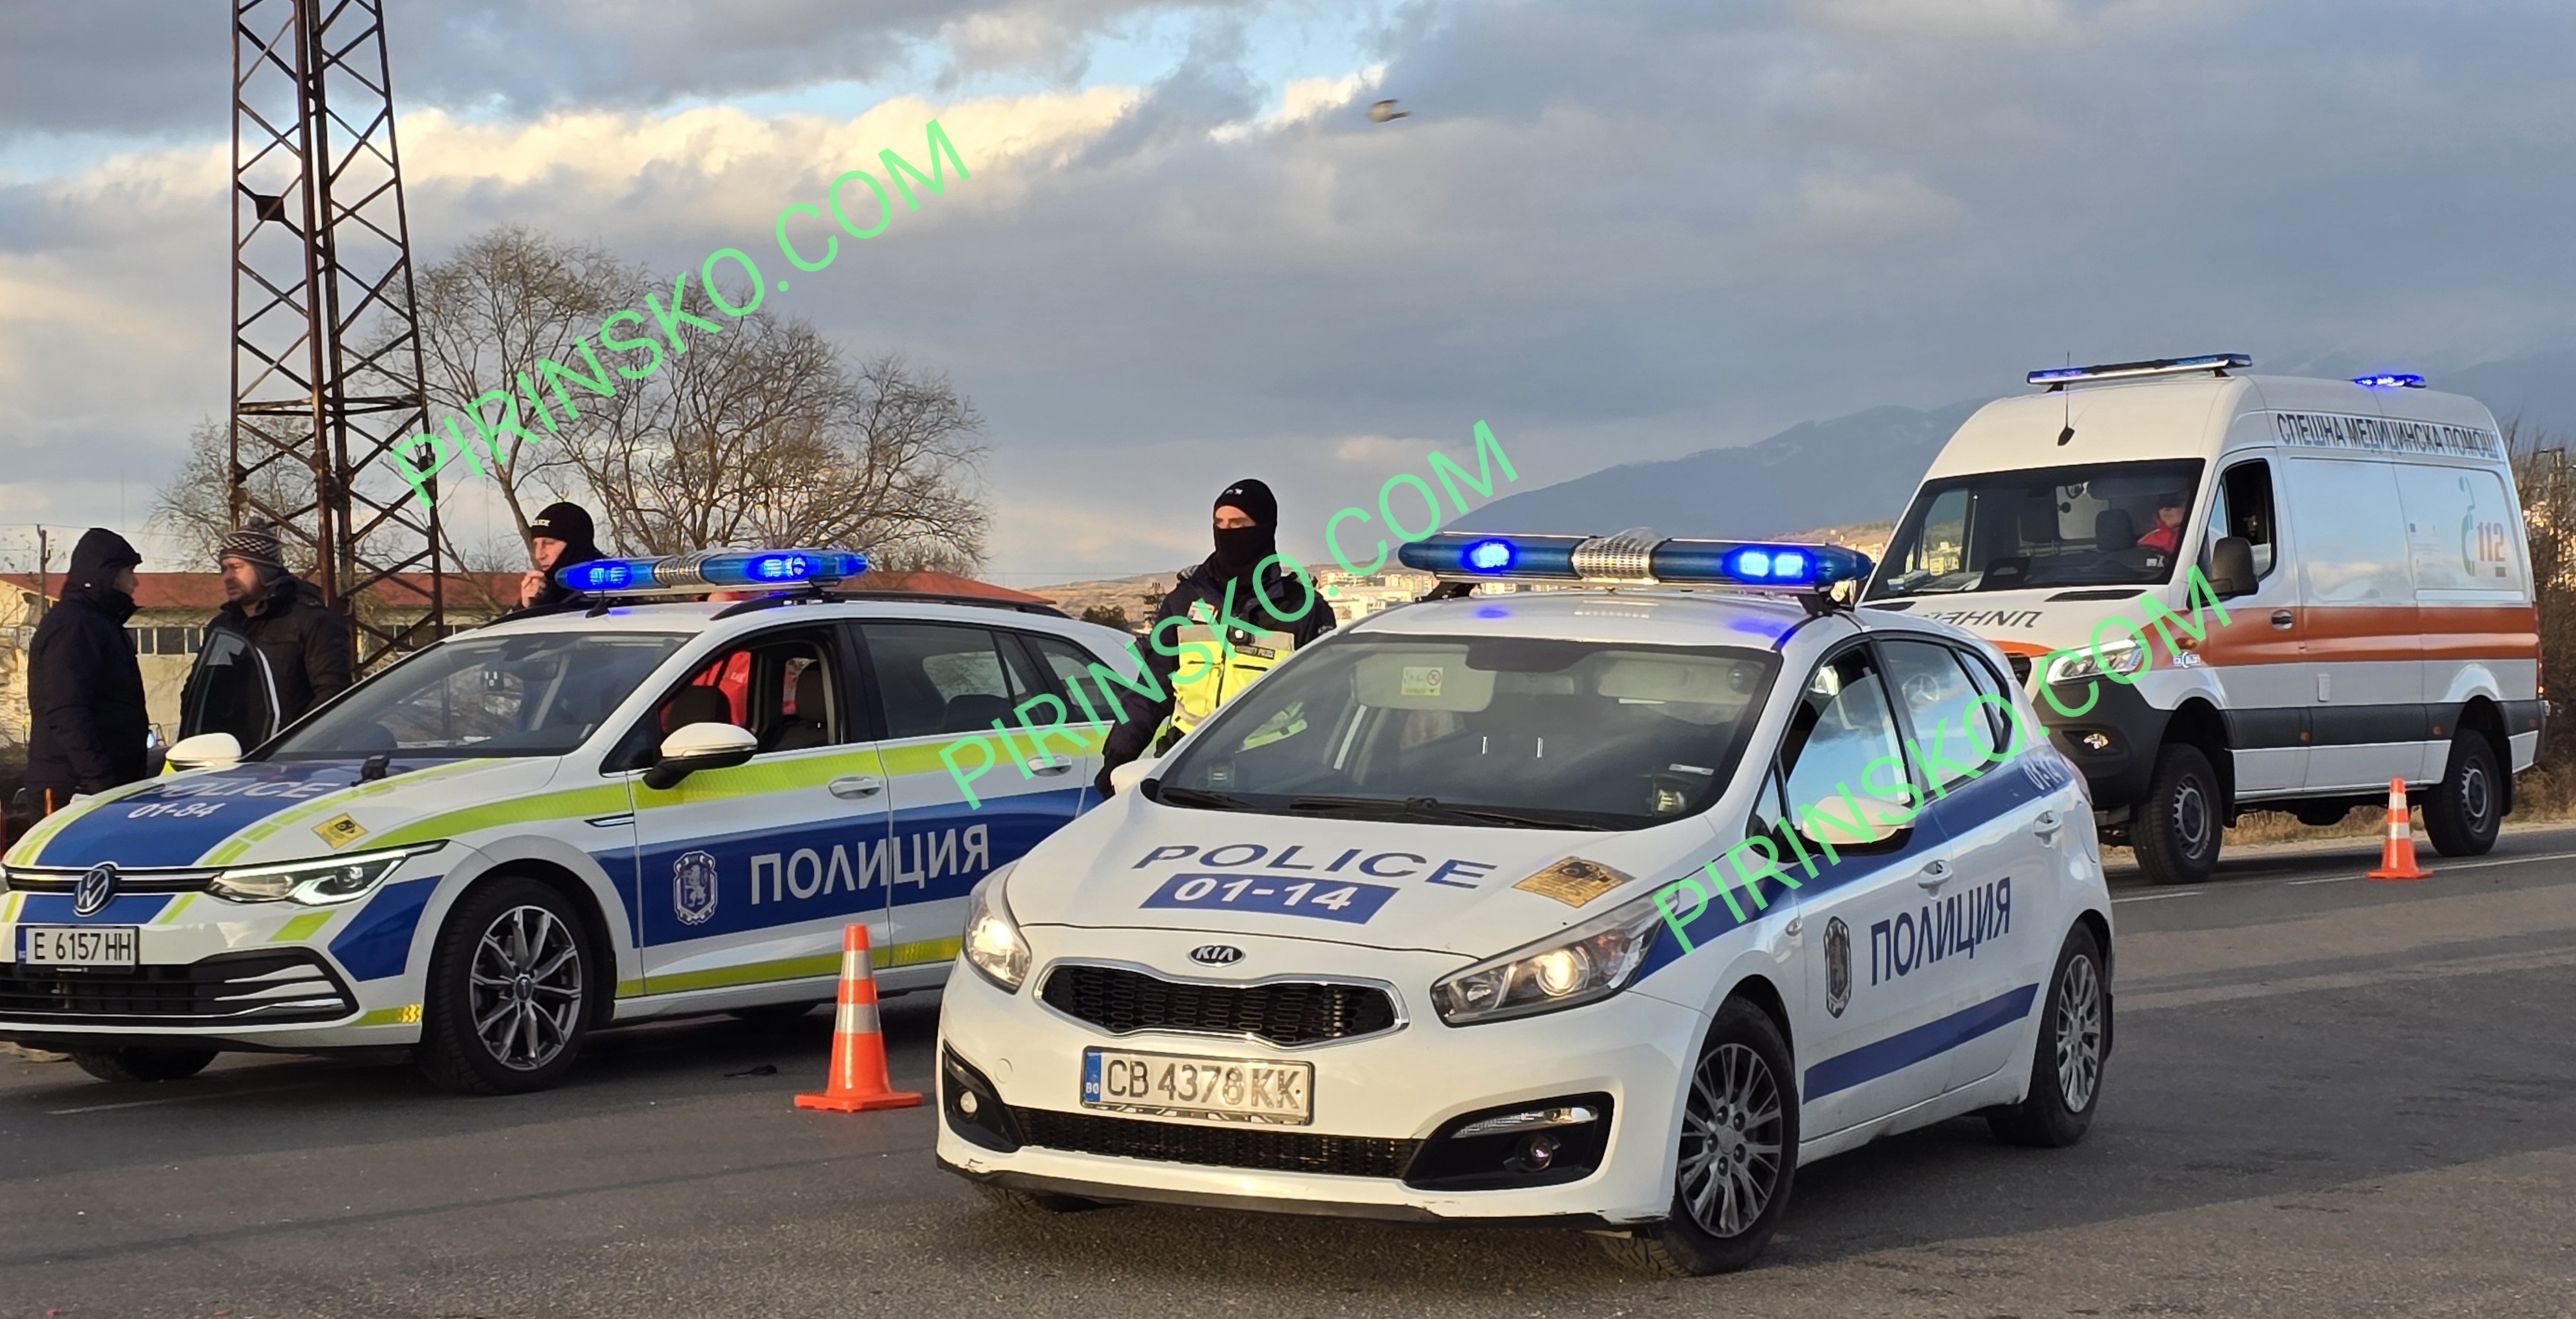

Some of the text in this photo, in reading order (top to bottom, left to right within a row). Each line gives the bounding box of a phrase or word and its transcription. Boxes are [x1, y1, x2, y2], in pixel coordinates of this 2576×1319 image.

[2276, 413, 2345, 447] СПЕШНА
[2344, 418, 2445, 455] МЕДИЦИНСКА
[2477, 522, 2506, 561] 112
[128, 803, 227, 819] 01-84
[750, 823, 989, 905] ПОЛИЦИЯ
[1131, 844, 1498, 890] POLICE
[1172, 877, 1360, 911] 01-14
[34, 933, 131, 961] E 6157 HH
[1871, 876, 2011, 987] ПОЛИЦИЯ
[1195, 947, 1234, 961] KIA
[1107, 1060, 1300, 1110] CB 4378 KK
